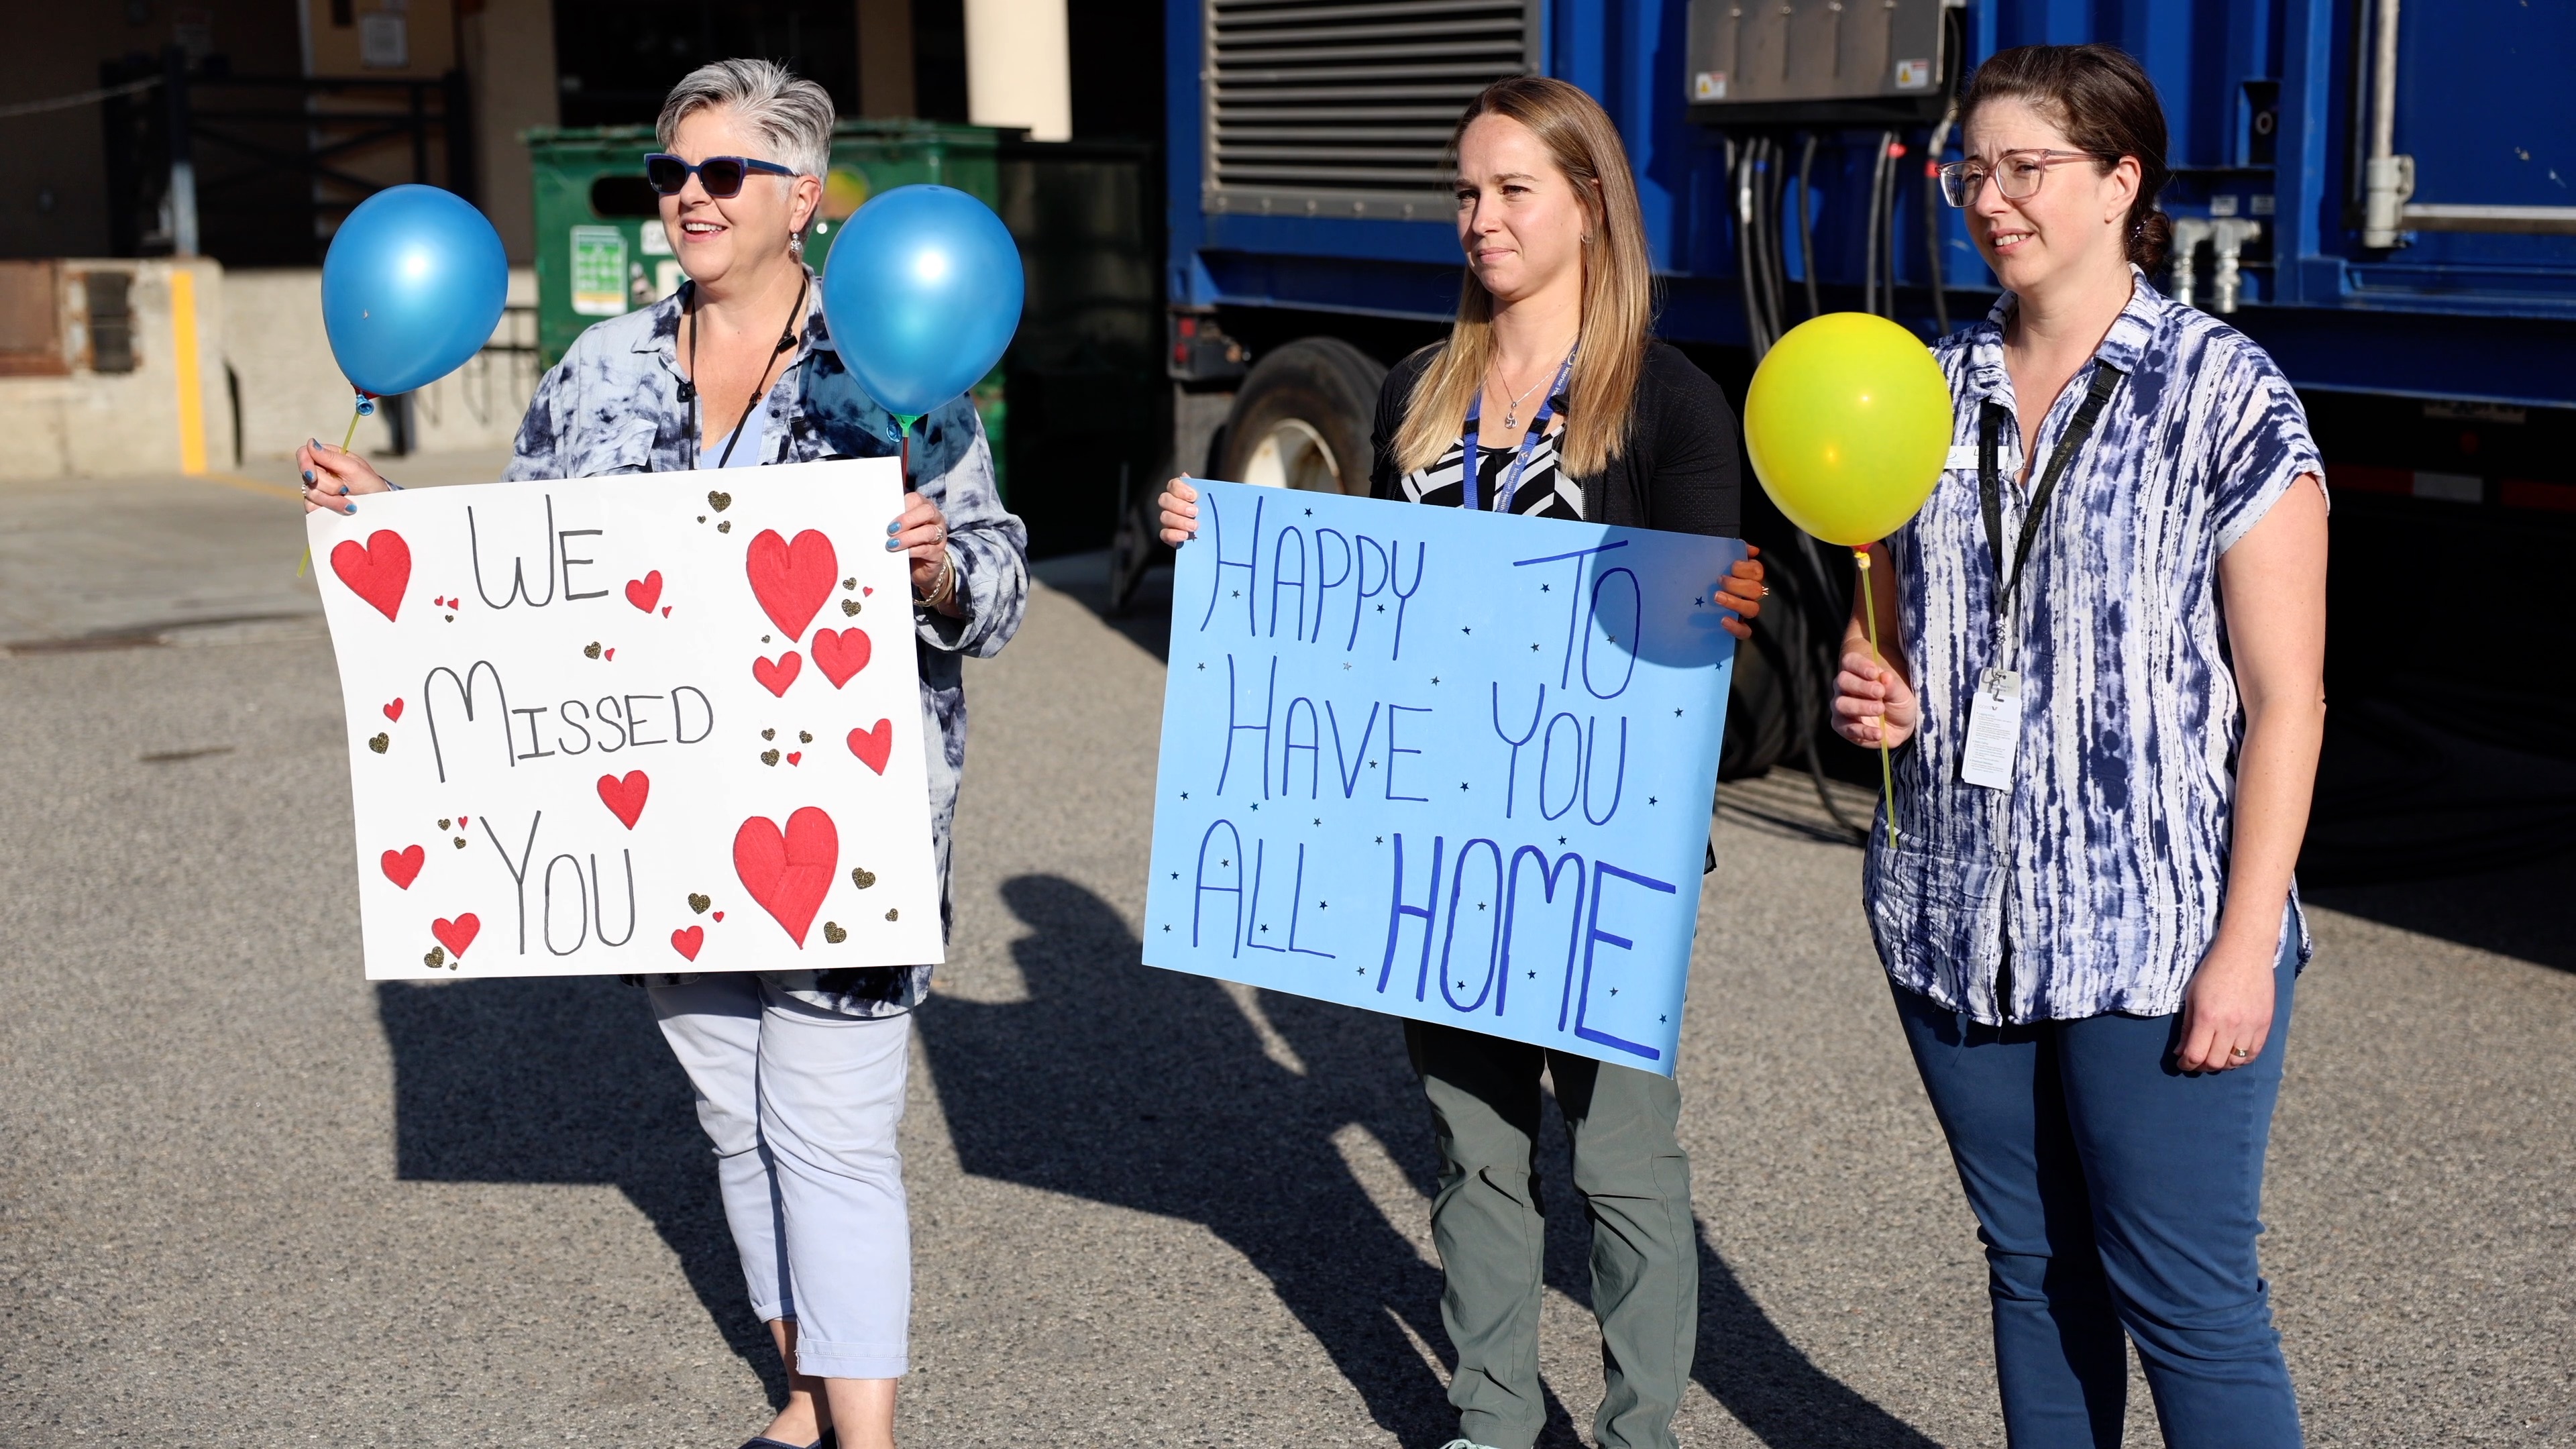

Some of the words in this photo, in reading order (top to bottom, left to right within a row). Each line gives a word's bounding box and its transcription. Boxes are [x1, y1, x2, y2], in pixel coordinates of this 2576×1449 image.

[1557, 366, 1571, 387] Interior
[1507, 468, 1520, 490] Interior
[468, 494, 609, 610] WE
[1201, 492, 1426, 661] HAPPY
[1513, 540, 1642, 700] TO
[424, 660, 714, 784] MISSED
[1217, 653, 1434, 802] HAVE
[1493, 682, 1627, 826] YOU
[480, 810, 636, 956] YOU
[1193, 819, 1337, 960] ALL
[1377, 833, 1676, 1061] HOME
